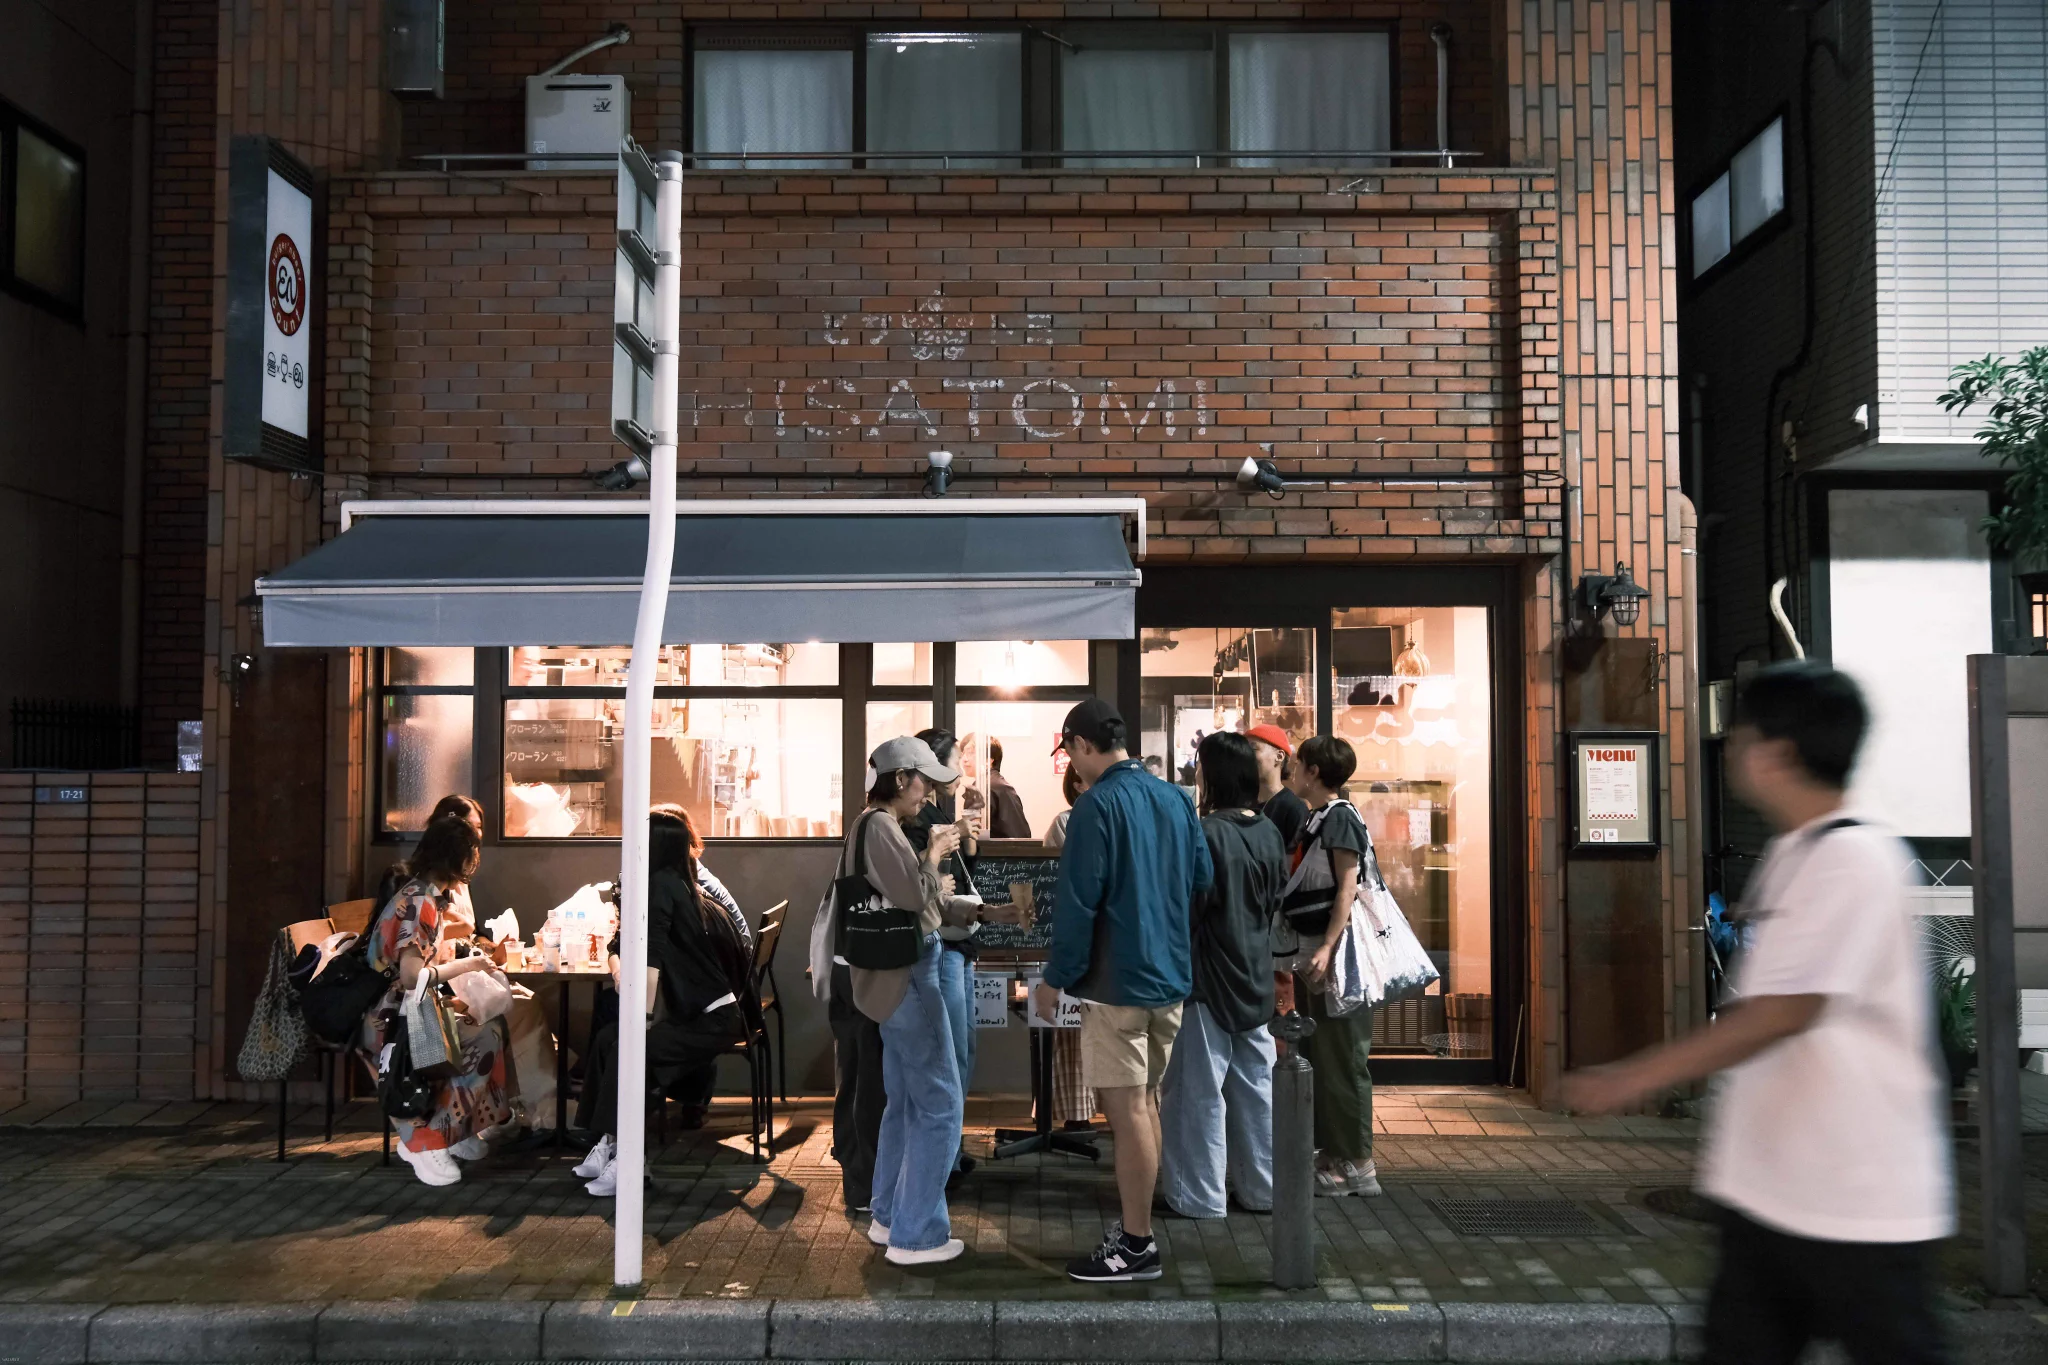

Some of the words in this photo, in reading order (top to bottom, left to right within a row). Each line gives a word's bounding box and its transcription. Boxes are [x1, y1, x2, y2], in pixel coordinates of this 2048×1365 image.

[271, 296, 302, 332] count
[694, 378, 1206, 438] HISATOMI
[505, 751, 549, 763] ワローラン
[1587, 749, 1636, 762] Menu
[60, 790, 83, 799] 17-21
[1104, 1254, 1128, 1272] N
